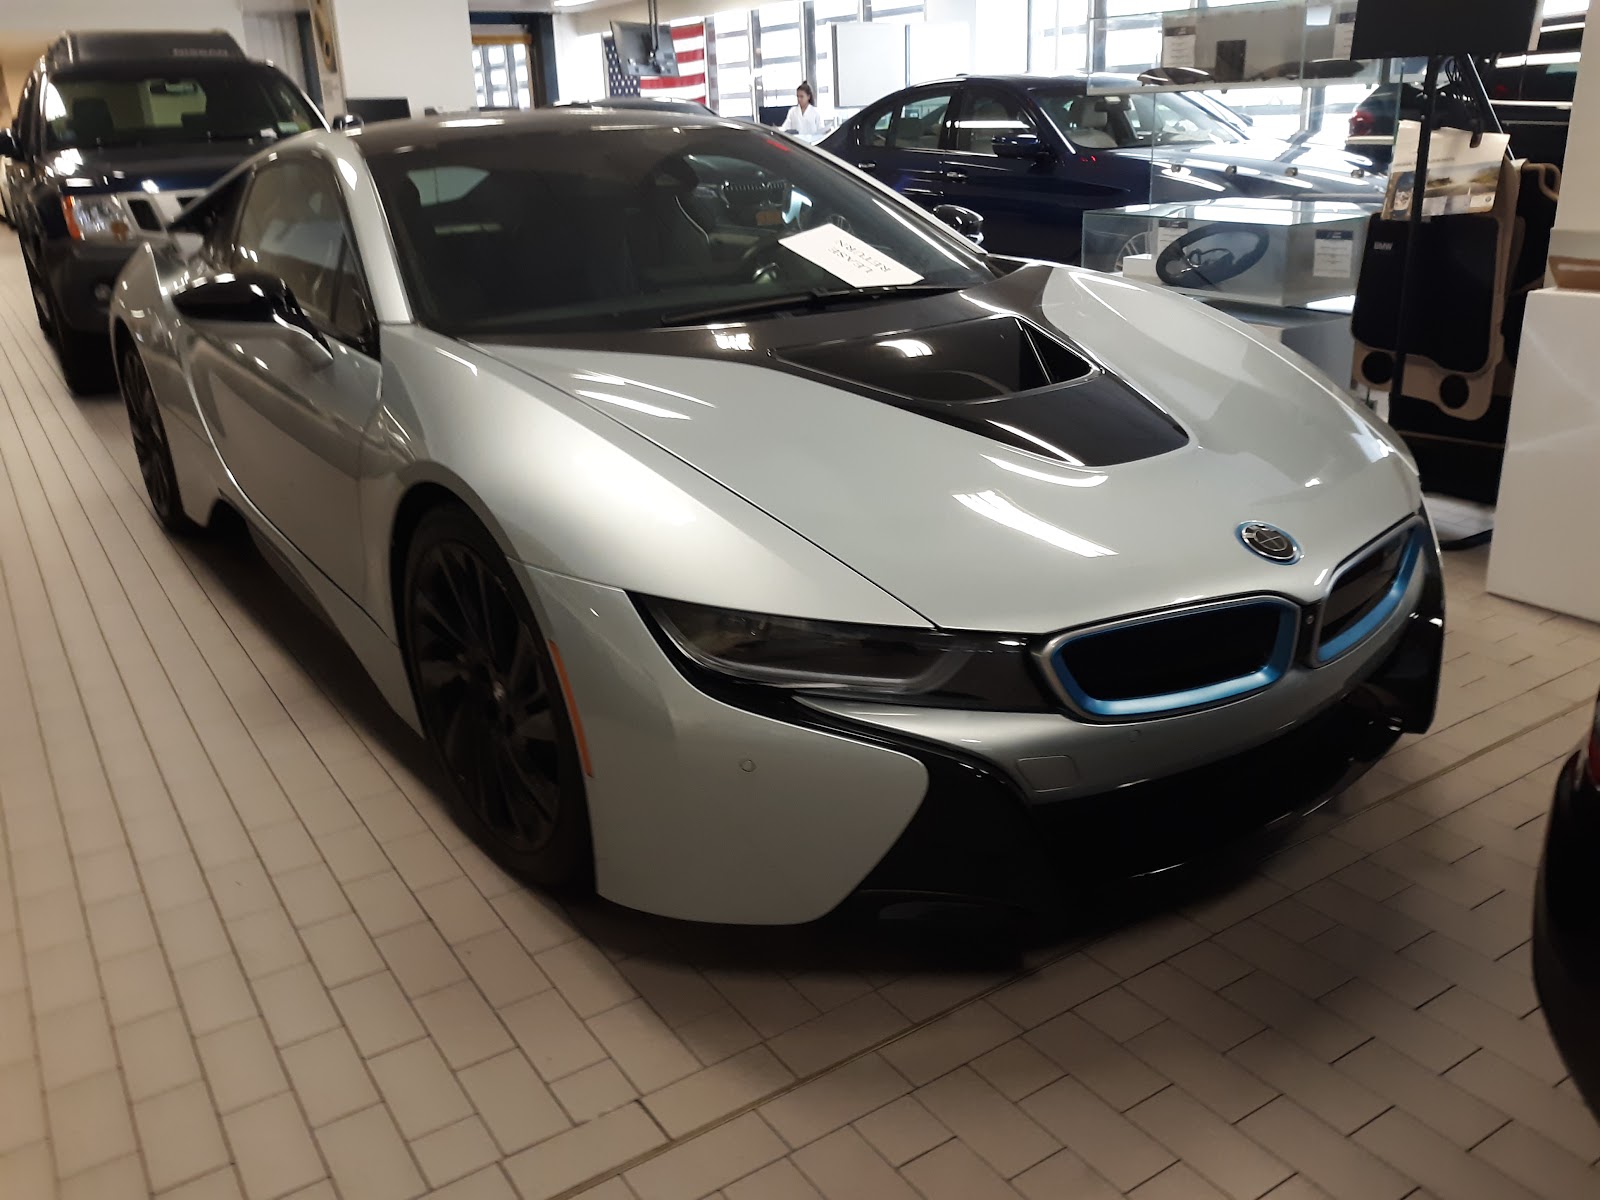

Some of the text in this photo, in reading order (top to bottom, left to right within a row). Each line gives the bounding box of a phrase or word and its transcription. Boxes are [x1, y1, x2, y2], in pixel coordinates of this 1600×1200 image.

[836, 239, 891, 273] RETURN
[1373, 241, 1393, 250] BMW
[828, 247, 873, 274] LEASE
